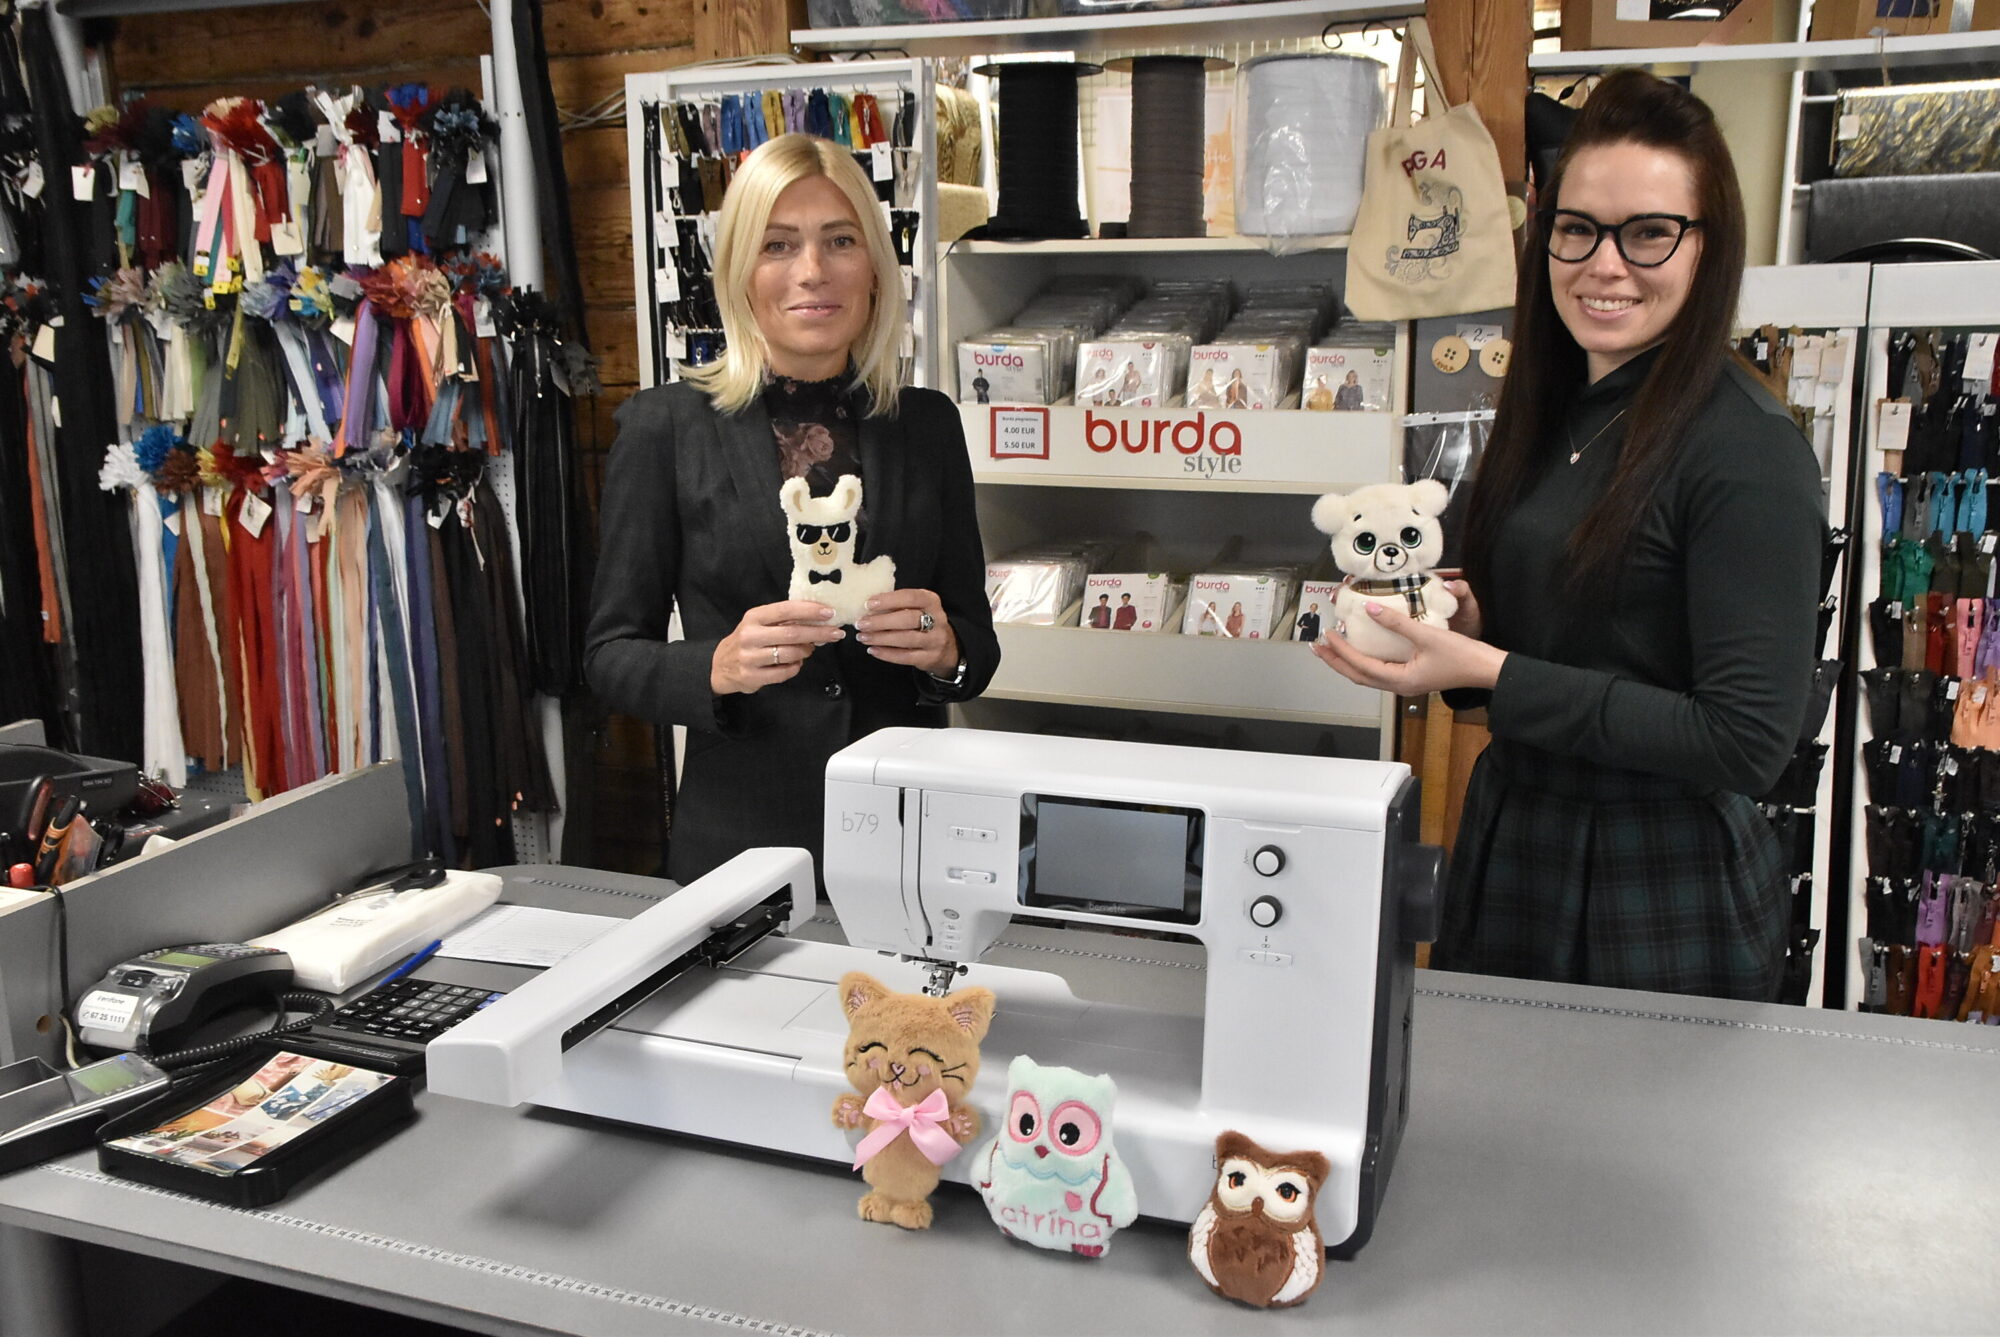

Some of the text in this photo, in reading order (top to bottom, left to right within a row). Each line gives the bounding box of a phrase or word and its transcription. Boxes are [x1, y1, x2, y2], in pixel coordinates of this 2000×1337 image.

[974, 351, 1023, 367] burda
[1193, 350, 1228, 360] burda
[1085, 410, 1242, 455] burda
[1004, 441, 1020, 449] 5.50
[1183, 452, 1242, 478] style
[1089, 578, 1122, 587] burda
[1196, 580, 1230, 590] burda
[1305, 585, 1335, 594] burd
[842, 810, 878, 834] b79
